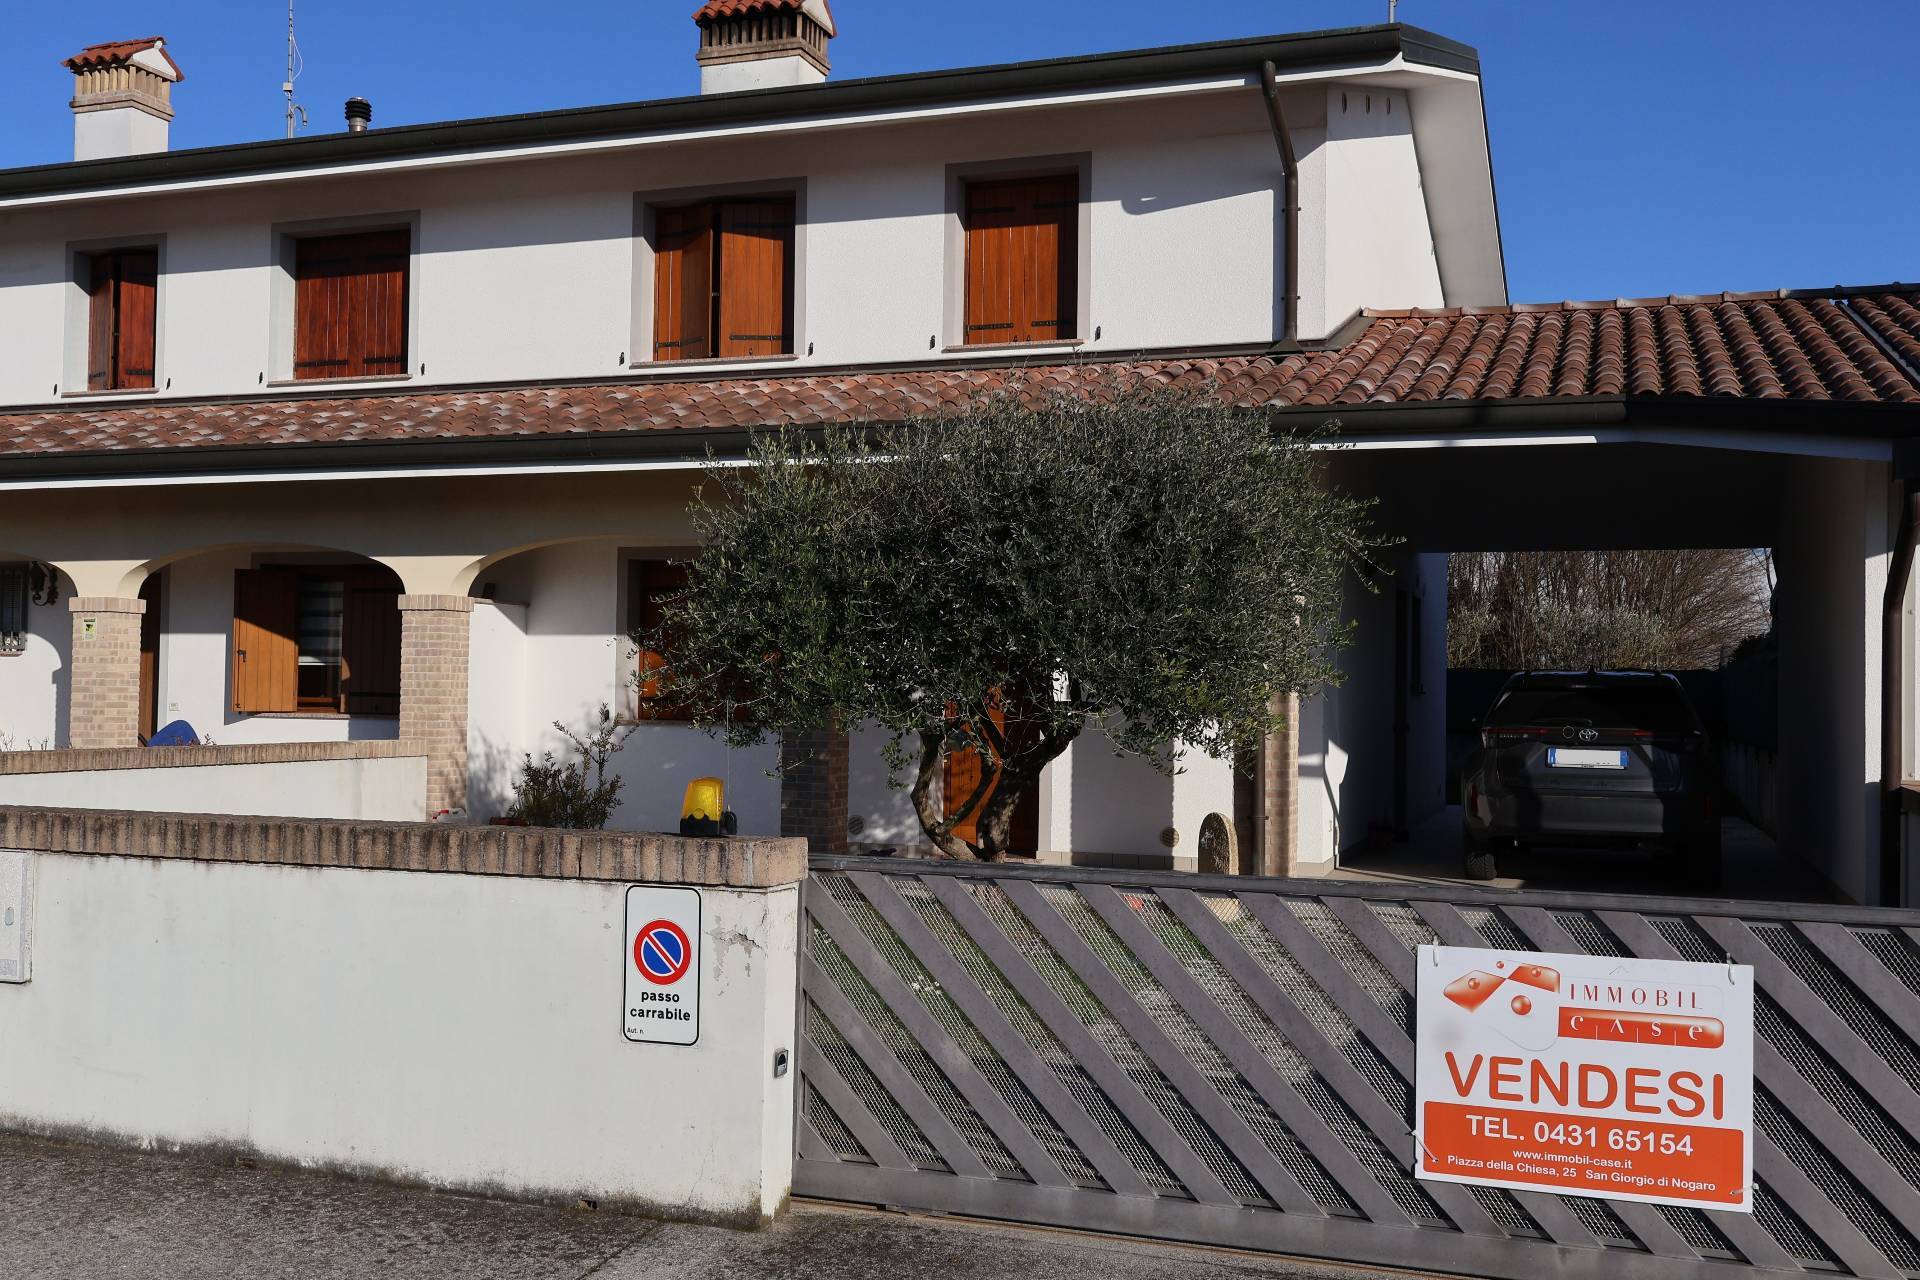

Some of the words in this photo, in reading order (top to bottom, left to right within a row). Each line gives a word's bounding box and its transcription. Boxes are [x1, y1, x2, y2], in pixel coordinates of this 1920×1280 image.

[641, 991, 680, 1003] passo
[1570, 983, 1703, 1010] IMMOBIL
[630, 1007, 691, 1021] carrabile
[1444, 1051, 1724, 1121] VENDESI
[1465, 1114, 1525, 1141] TEL.
[1534, 1120, 1597, 1148] 0431
[1608, 1127, 1693, 1157] 65154
[1512, 1148, 1633, 1170] www.immobil-case.it
[1447, 1155, 1484, 1168] Piazza
[1486, 1159, 1514, 1171] della
[1516, 1162, 1560, 1177] Chiesa,
[1562, 1167, 1577, 1178] 25
[1585, 1169, 1608, 1181] San
[1611, 1172, 1655, 1187] Giorgio
[1657, 1176, 1669, 1187] di
[1671, 1177, 1716, 1192] Nogaro
